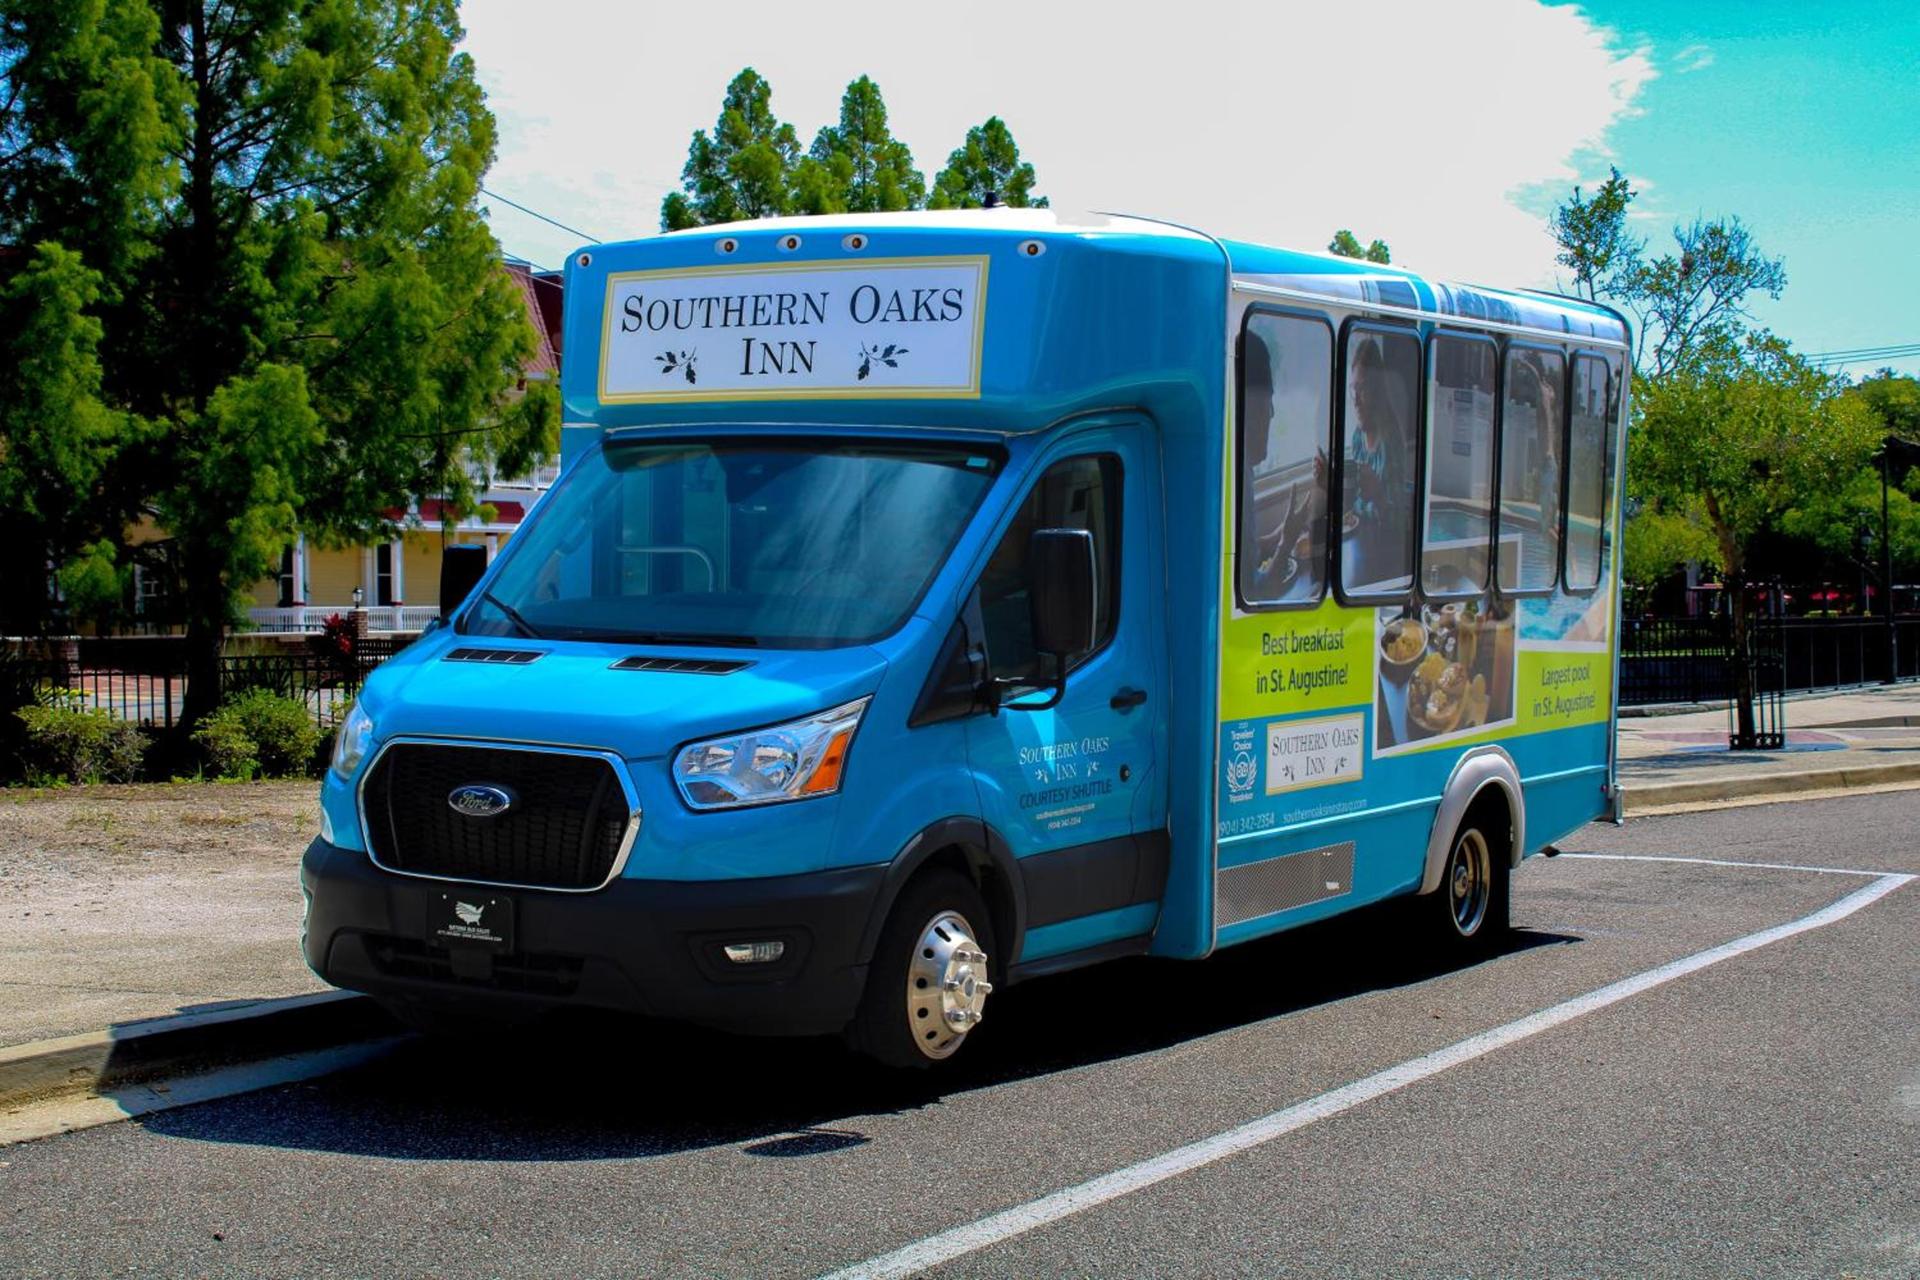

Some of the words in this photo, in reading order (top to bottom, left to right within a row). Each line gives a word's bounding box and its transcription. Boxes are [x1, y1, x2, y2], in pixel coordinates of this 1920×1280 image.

[621, 291, 830, 333] SOUTHERN
[849, 284, 963, 323] OAKS
[739, 337, 817, 376] INN
[1262, 632, 1289, 656] Best
[1291, 628, 1345, 654] breakfast
[1256, 671, 1268, 694] in
[1270, 668, 1286, 693] St.
[1288, 663, 1348, 696] Augustine!
[1541, 667, 1571, 690] Largest
[1533, 698, 1542, 718] in
[1019, 742, 1078, 765] SOUTHERN
[1081, 737, 1110, 755] OAKS
[1272, 732, 1329, 757] SOUTHERN
[1332, 728, 1360, 748] OAKS
[1056, 763, 1077, 781] INN
[1305, 756, 1326, 776] INN
[458, 790, 493, 810] Ford
[1020, 789, 1070, 810] COURTESY
[1072, 780, 1112, 799] SHUTTLE
